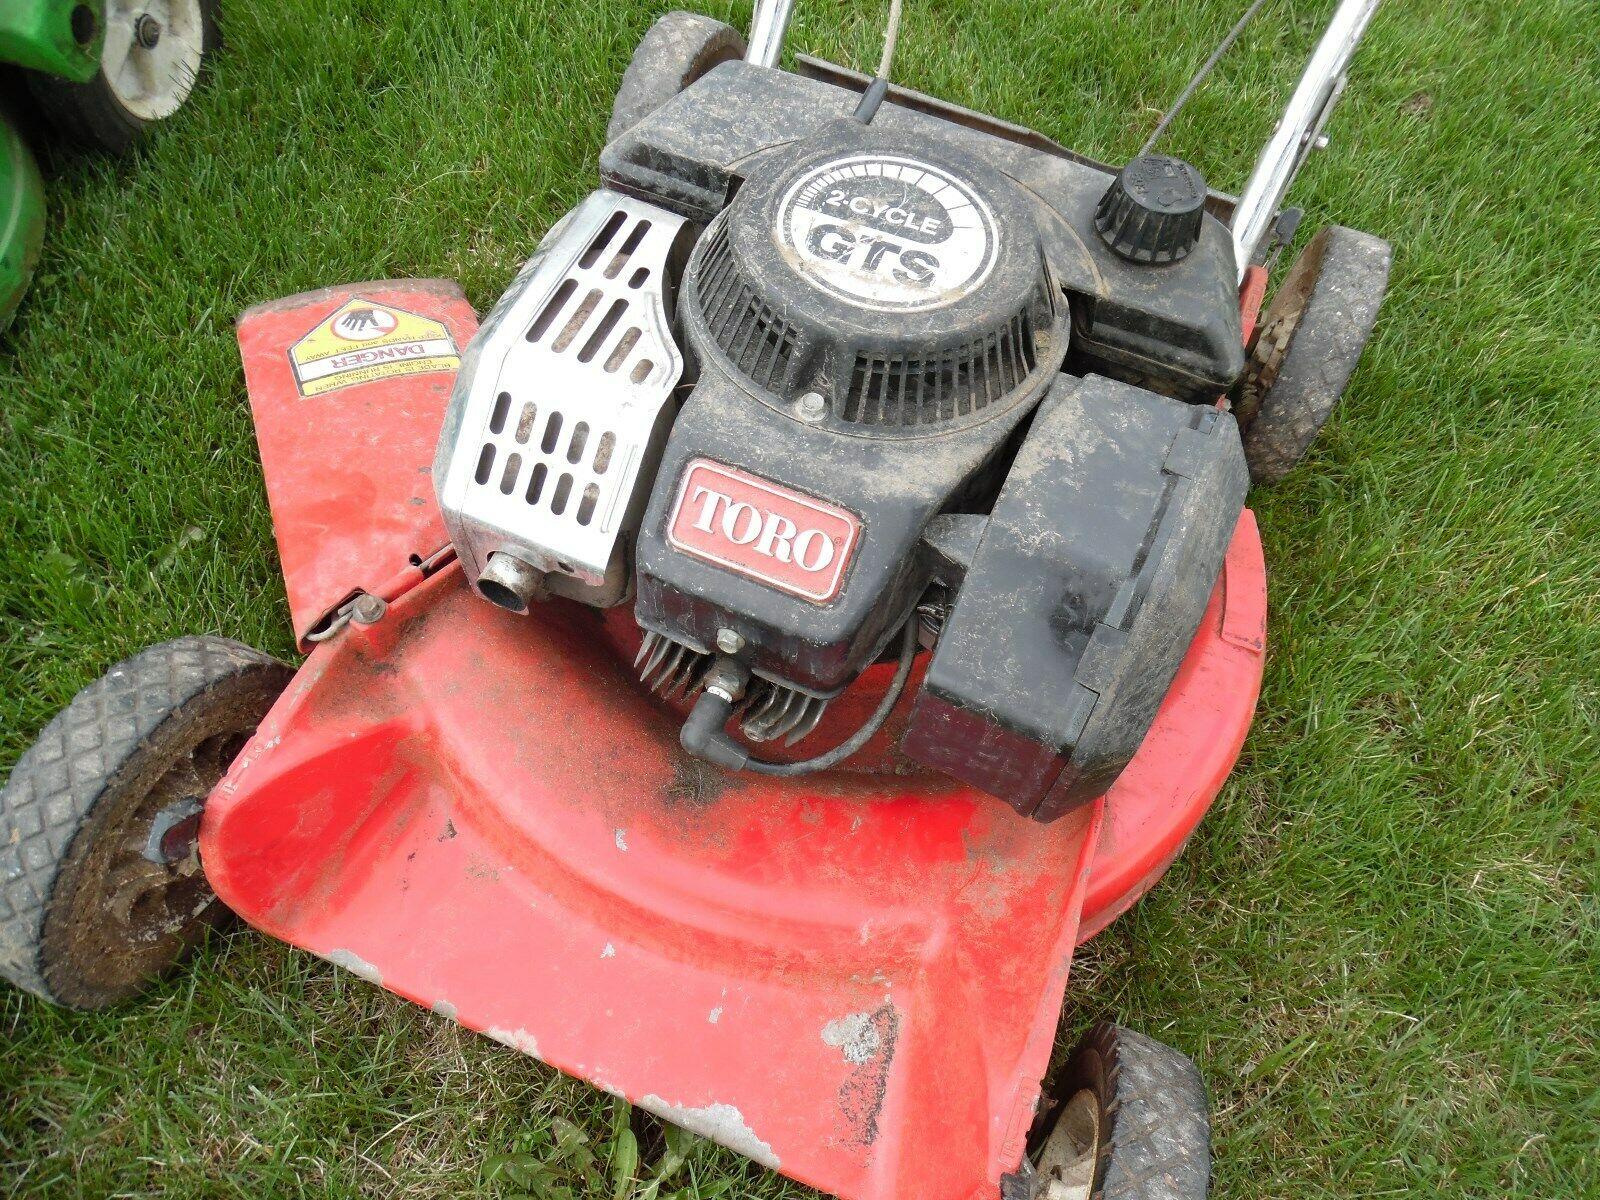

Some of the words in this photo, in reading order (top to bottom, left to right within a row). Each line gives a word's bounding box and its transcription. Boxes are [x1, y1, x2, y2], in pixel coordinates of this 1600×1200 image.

[808, 224, 940, 288] GTS
[305, 351, 330, 361] AWAY
[331, 344, 425, 369] DANGER
[334, 367, 381, 380] RUNNING
[350, 369, 401, 384] ROTATING
[315, 380, 348, 391] WHEN
[691, 485, 835, 572] TORO
